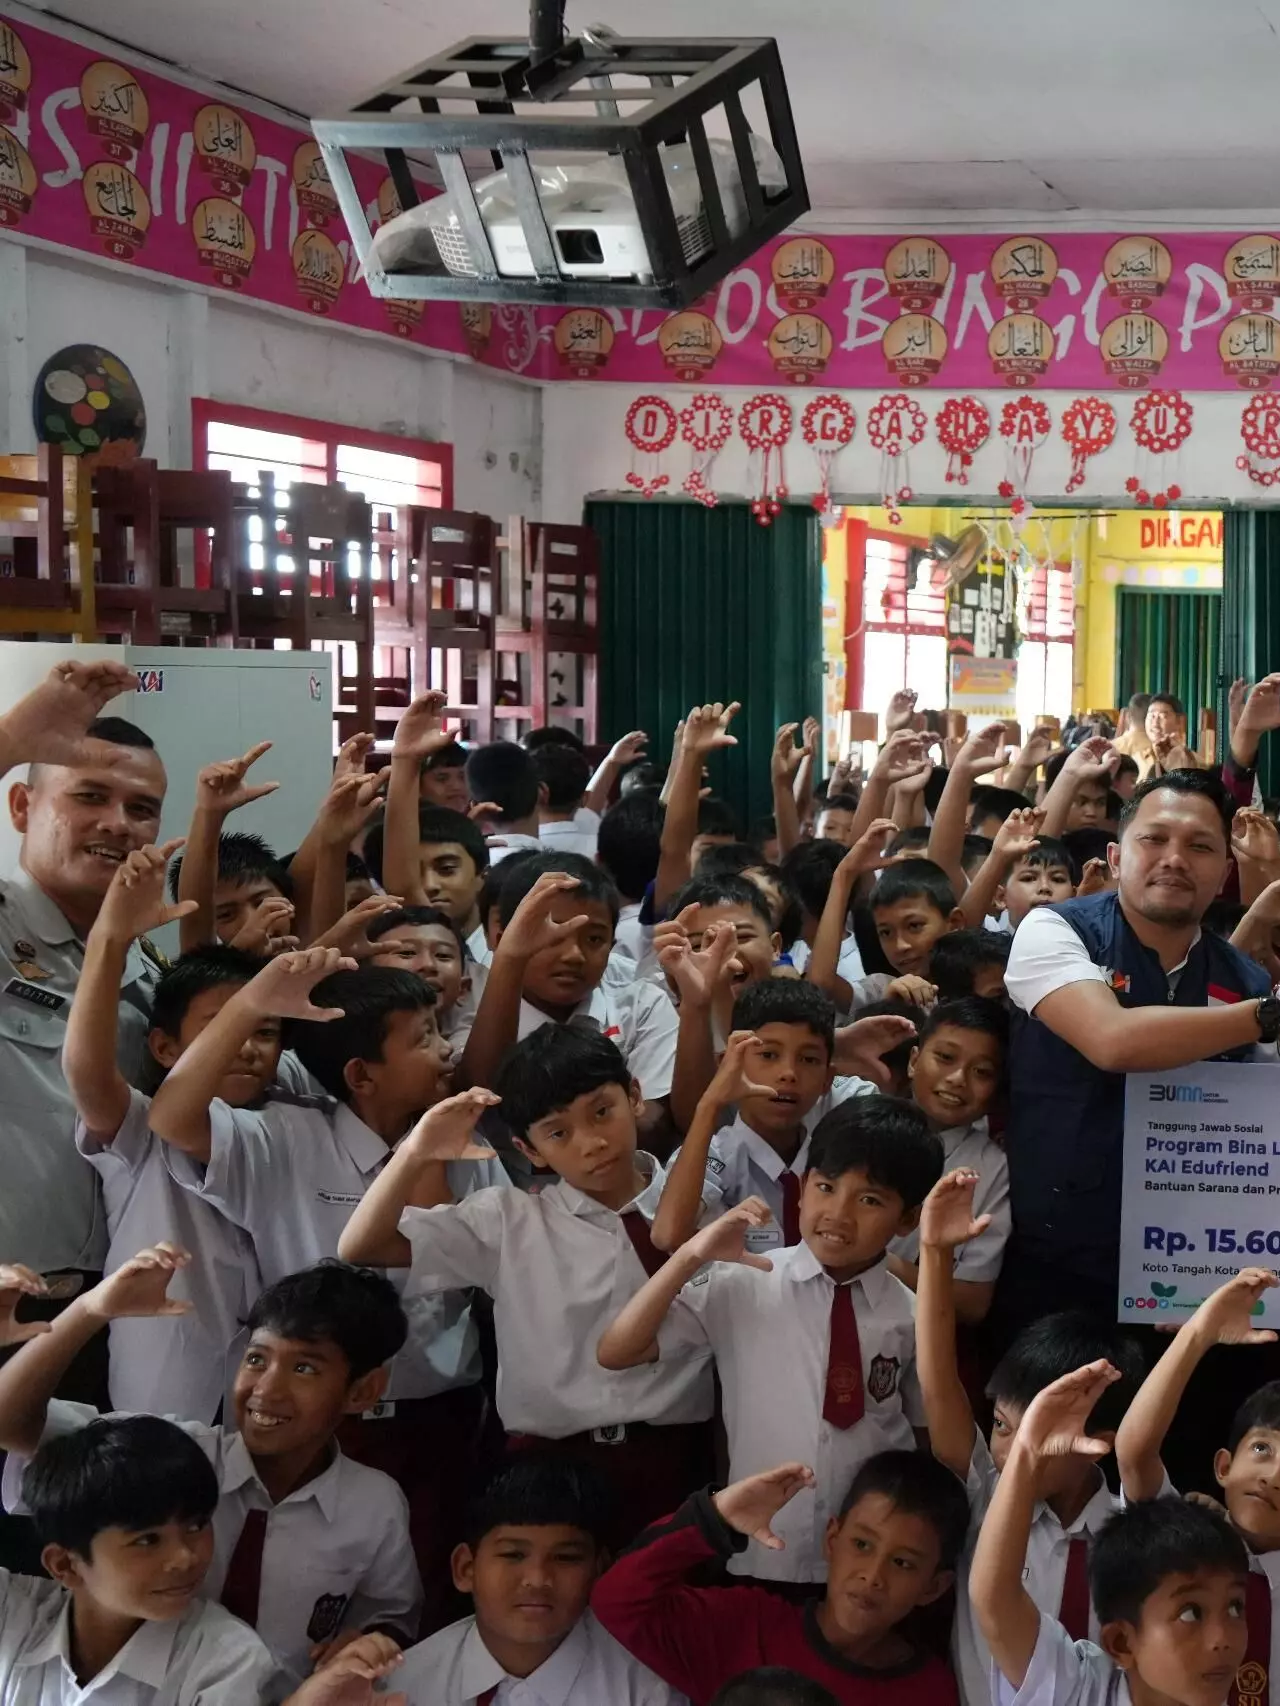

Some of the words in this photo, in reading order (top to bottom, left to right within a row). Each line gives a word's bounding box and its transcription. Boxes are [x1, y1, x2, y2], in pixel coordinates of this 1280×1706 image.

[642, 407, 1168, 441] DIRGAHAYU
[137, 670, 163, 692] KAI
[1147, 1121, 1197, 1134] Tanggung
[1199, 1122, 1231, 1133] Jawab
[1233, 1123, 1263, 1134] Sosial
[1145, 1137, 1223, 1156] Program
[1228, 1139, 1267, 1155] Bina
[1145, 1159, 1176, 1175] KAI
[1181, 1160, 1269, 1177] Edufriend
[1145, 1180, 1195, 1192] Bantuan
[1198, 1182, 1239, 1194] Sarana
[1242, 1184, 1265, 1195] dan
[1143, 1226, 1195, 1258] Rp.
[1142, 1262, 1169, 1273] Koto
[1172, 1263, 1212, 1276] Tangah
[1215, 1265, 1240, 1276] Kota
